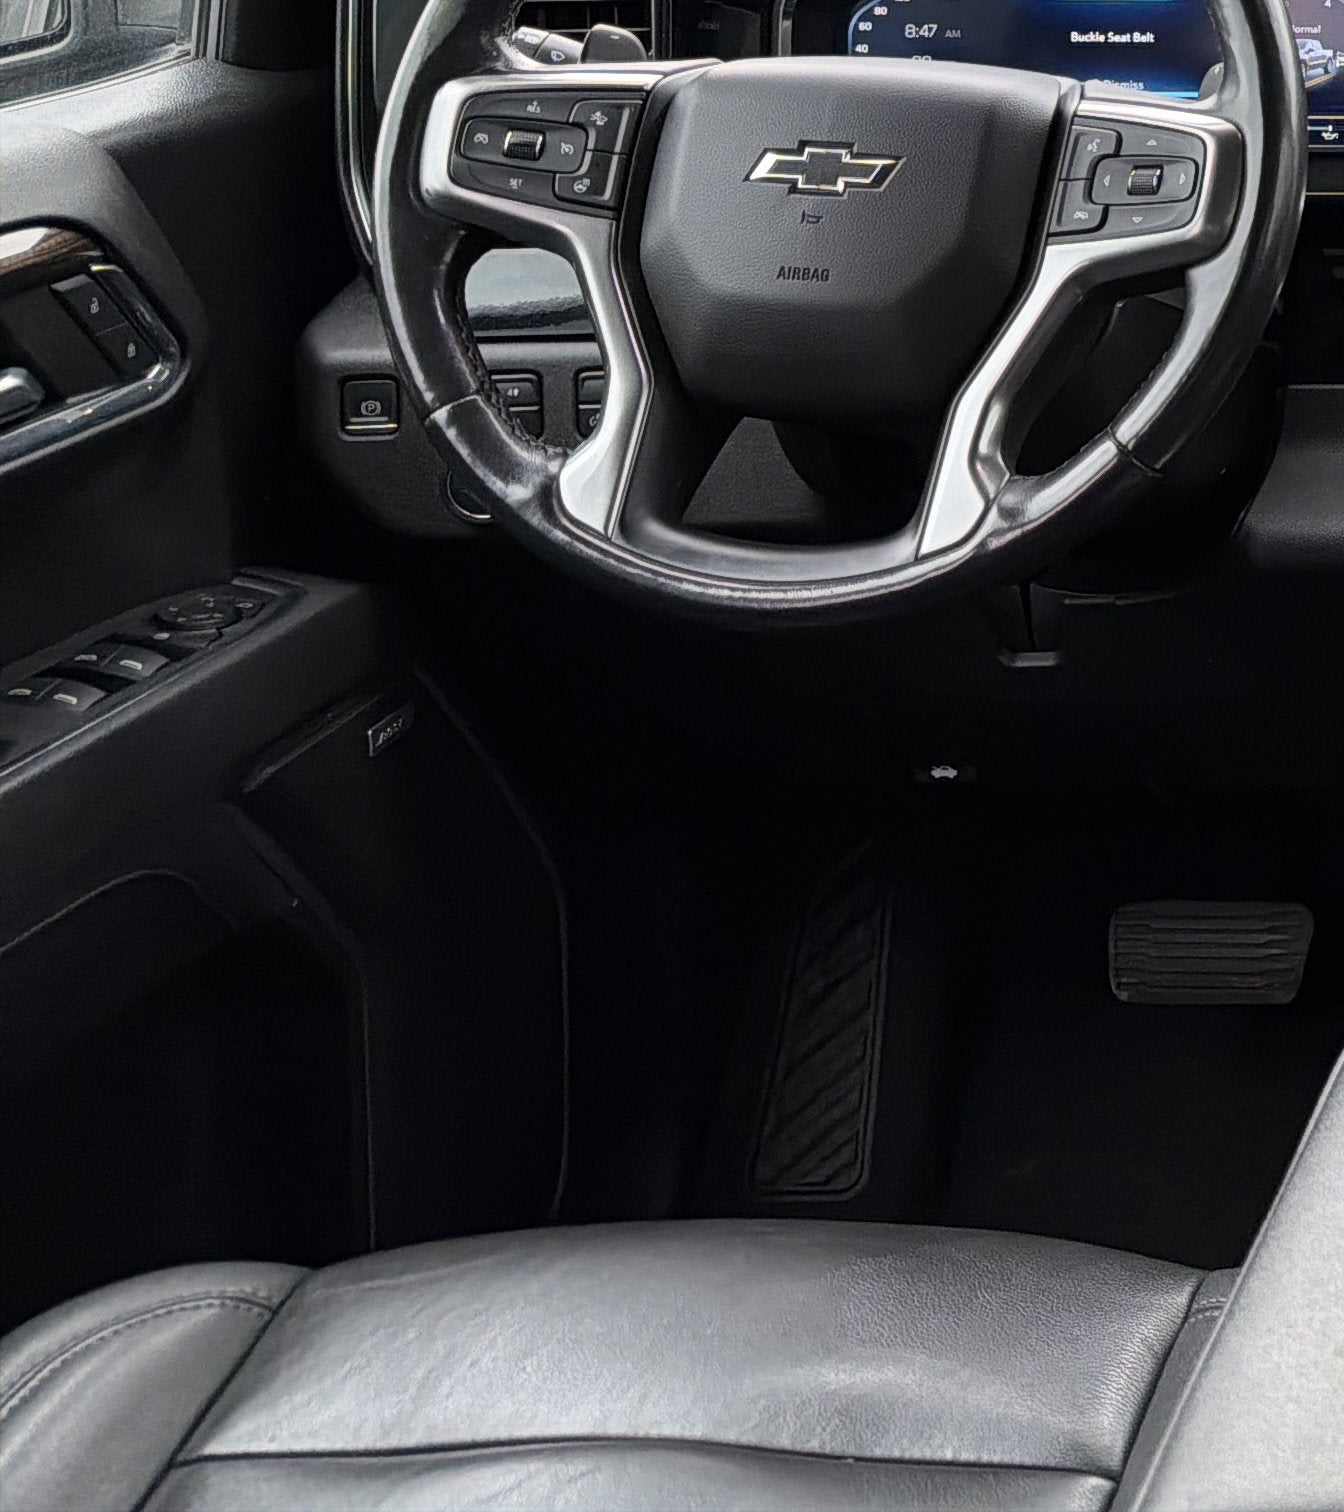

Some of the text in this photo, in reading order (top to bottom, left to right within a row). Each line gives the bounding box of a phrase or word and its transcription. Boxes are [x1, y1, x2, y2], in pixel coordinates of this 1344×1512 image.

[874, 6, 888, 16] 80
[858, 22, 873, 31] 60
[904, 23, 962, 39] 8:47 AM
[1291, 24, 1322, 34] ormal
[1070, 32, 1156, 43] Buckle Seat Belt
[855, 43, 869, 54] 40
[776, 265, 831, 283] AIRBAG
